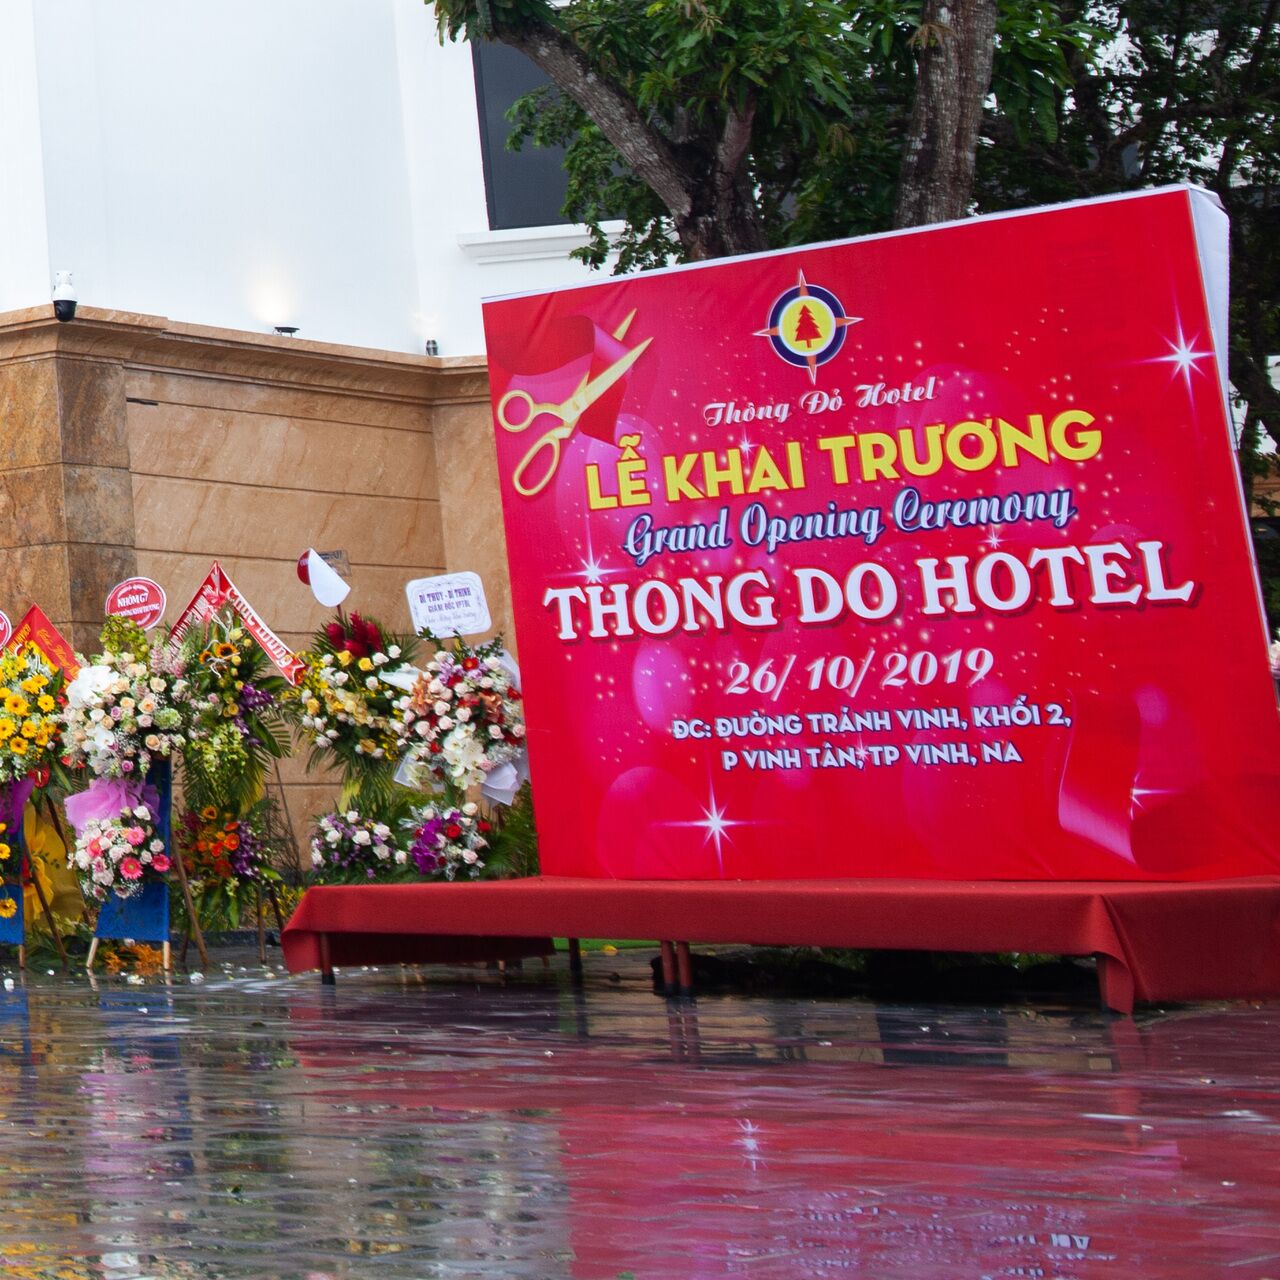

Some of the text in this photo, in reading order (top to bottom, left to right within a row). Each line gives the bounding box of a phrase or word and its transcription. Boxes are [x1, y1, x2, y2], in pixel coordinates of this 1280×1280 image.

[703, 401, 790, 427] Thông
[856, 375, 937, 408] Hotel
[585, 409, 1102, 510] LỄ KHAI TRƯƠNG
[623, 485, 1077, 567] Grand Opening Ceremony
[117, 592, 149, 608] NHÓM G7
[542, 540, 1195, 640] THONG DO HOTEL
[672, 693, 1072, 740] ĐC: ĐƯỜNG TRÁNH VINH, KHỐI 2,
[722, 741, 1023, 771] P VINH TÂN, TP VINH, NA
